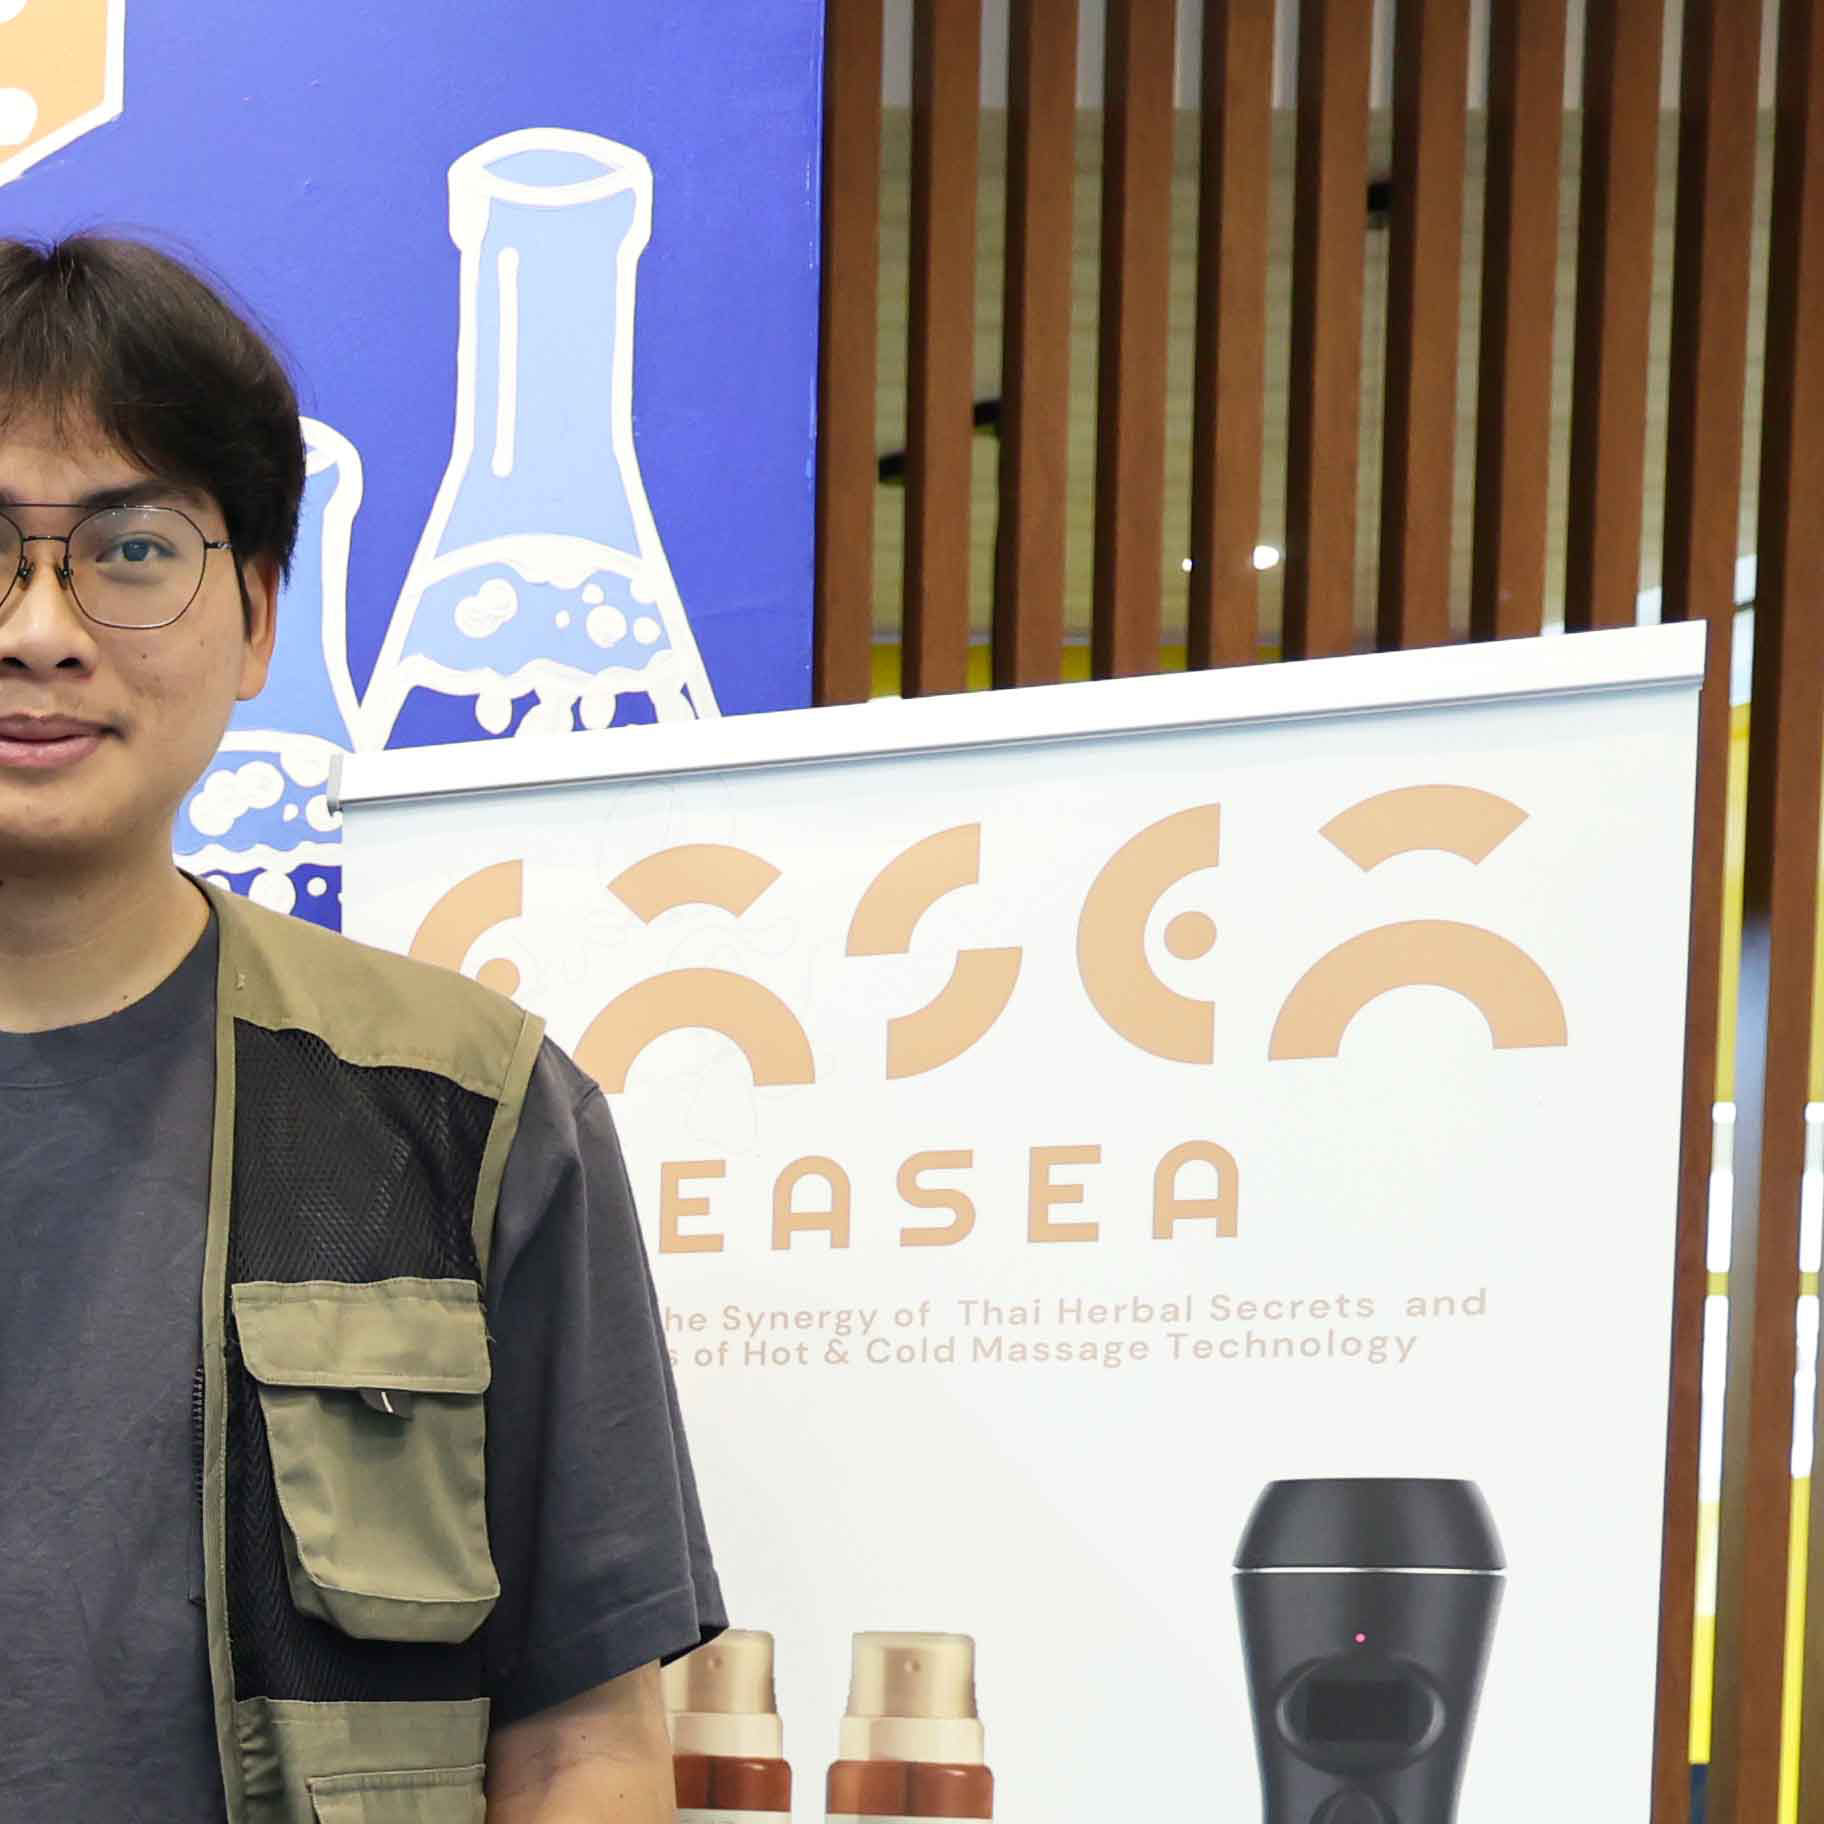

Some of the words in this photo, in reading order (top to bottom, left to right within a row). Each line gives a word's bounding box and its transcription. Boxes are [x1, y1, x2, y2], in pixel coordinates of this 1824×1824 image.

[660, 1142, 1238, 1255] EASEA
[664, 1304, 707, 1333] he
[723, 1305, 878, 1338] Synergy
[894, 1301, 930, 1328] of
[958, 1299, 1040, 1326] Thai
[1058, 1295, 1192, 1324] Herbal
[1210, 1294, 1374, 1321] Secrets
[1406, 1288, 1486, 1317] and
[694, 1340, 728, 1367] of
[744, 1340, 808, 1367] Hot
[824, 1338, 848, 1365] &
[866, 1336, 954, 1364] Cold
[972, 1336, 1149, 1368] Massage
[1167, 1328, 1416, 1364] Technology
